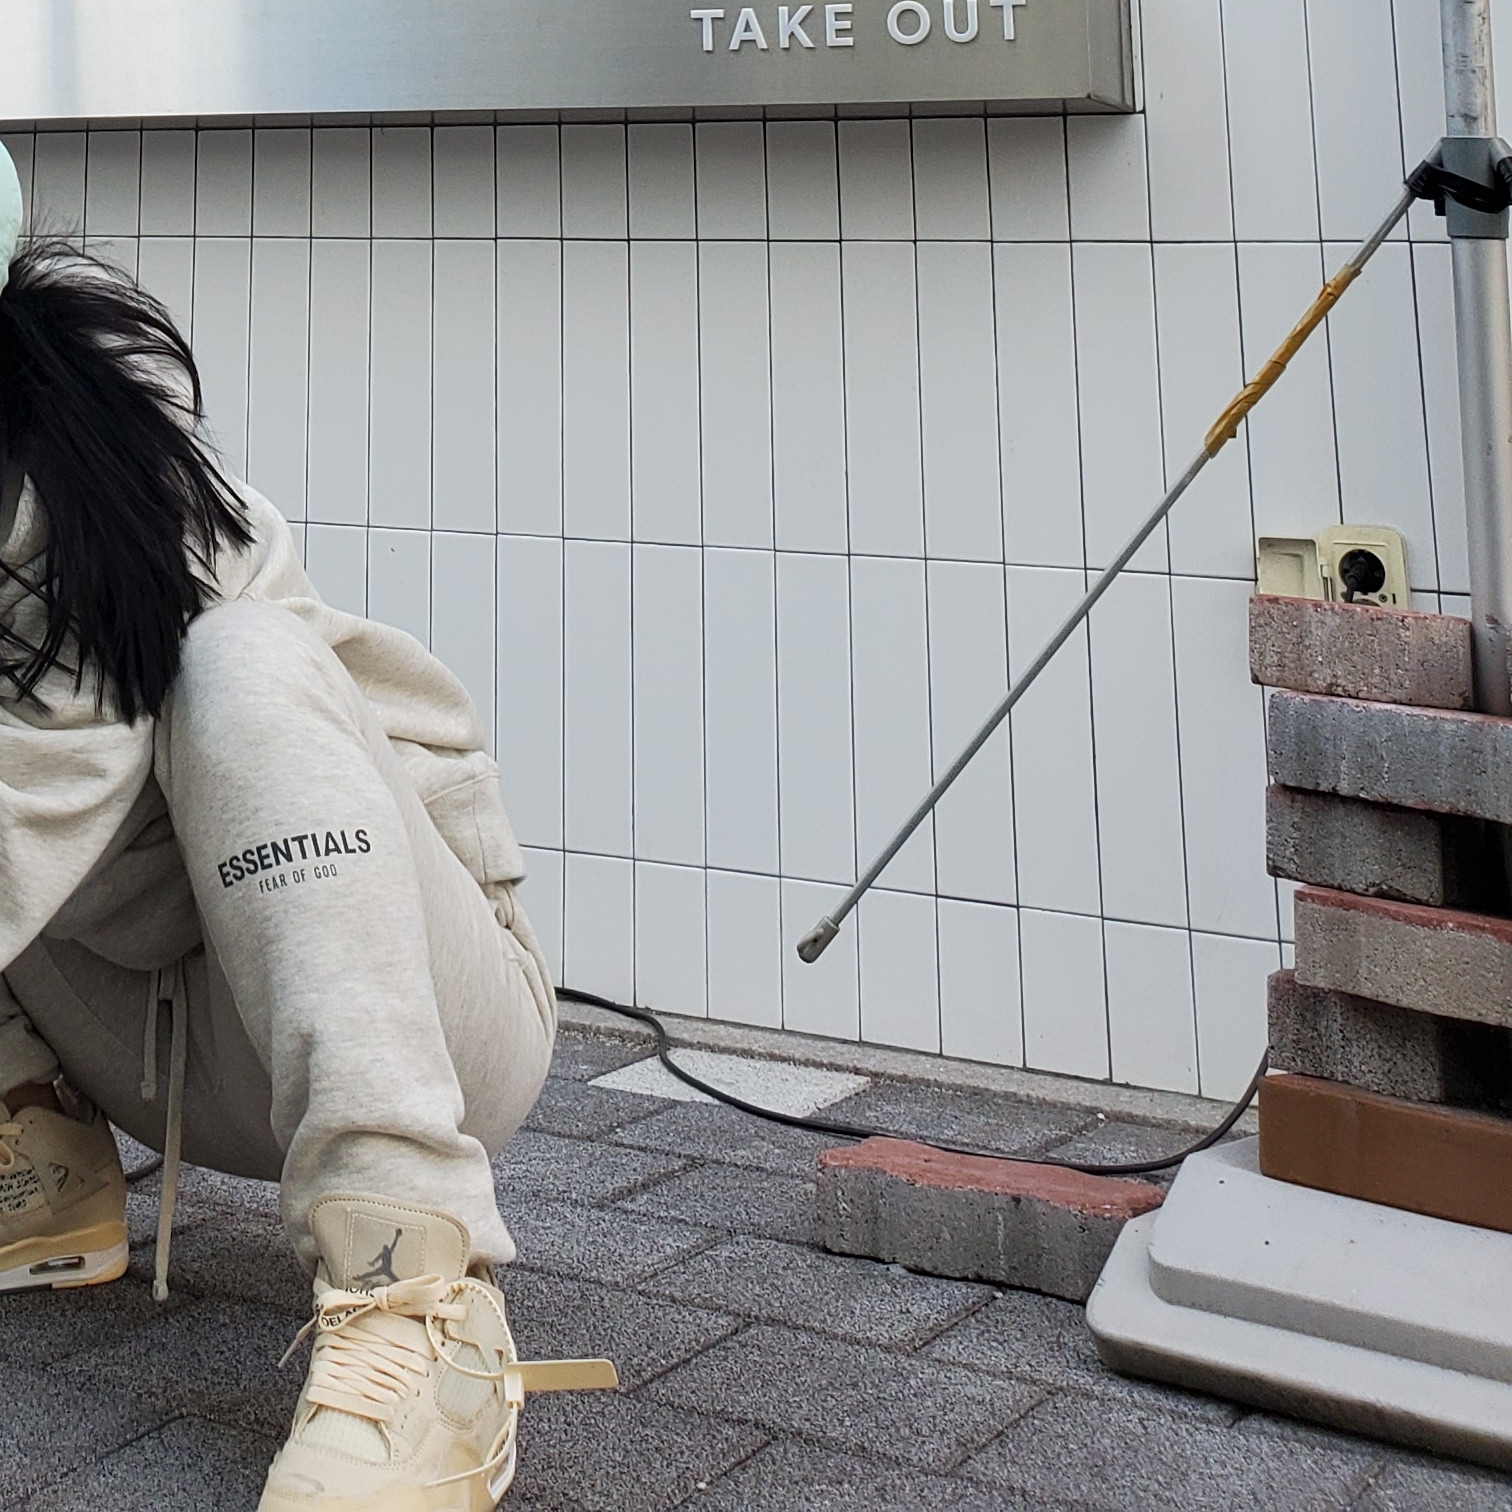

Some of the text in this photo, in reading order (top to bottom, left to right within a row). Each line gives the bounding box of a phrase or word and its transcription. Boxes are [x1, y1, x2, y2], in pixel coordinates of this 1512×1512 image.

[690, 3, 855, 52] TAKE
[217, 828, 372, 888] ESSENTIALS
[259, 863, 337, 894] FEAR OF GOD
